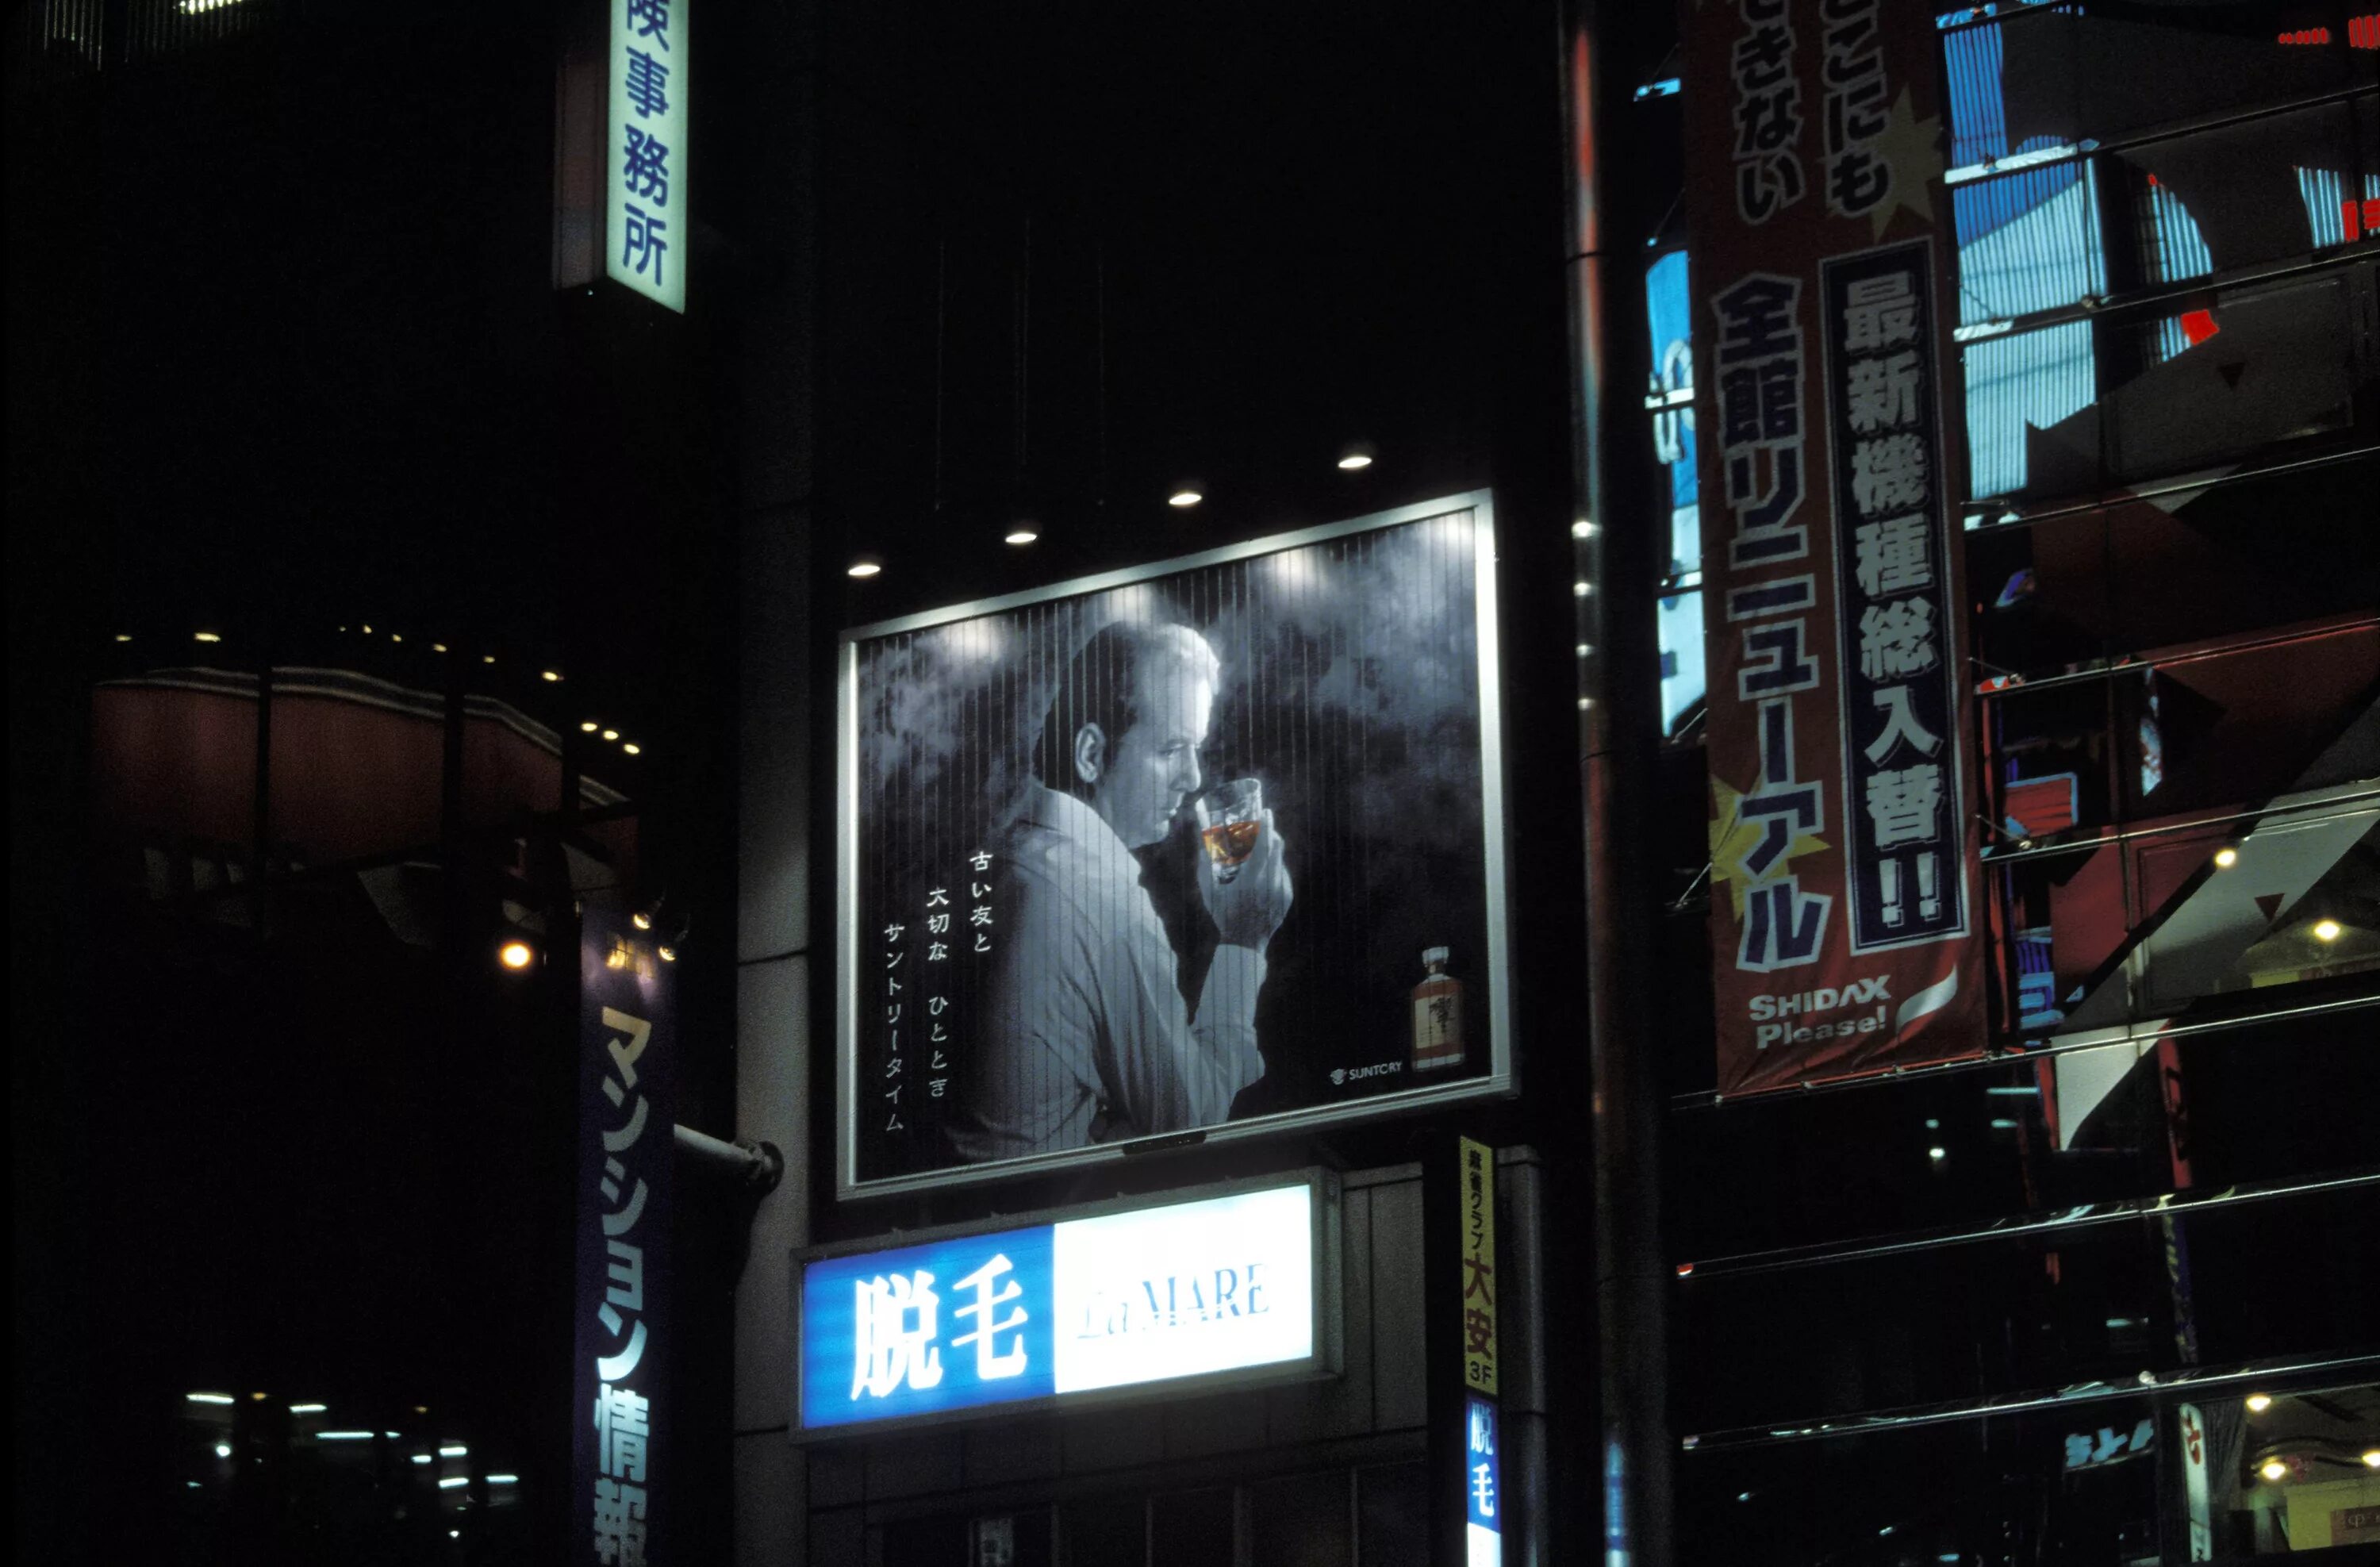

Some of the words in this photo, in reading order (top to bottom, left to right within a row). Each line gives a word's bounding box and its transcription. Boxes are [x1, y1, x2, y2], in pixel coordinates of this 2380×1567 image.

[926, 887, 950, 962] 大切な
[969, 851, 993, 953] 古い友と
[884, 924, 905, 1131] サントリータイム
[1748, 974, 1892, 1022] SHIDAX
[1756, 1005, 1887, 1050] Please!
[593, 1005, 652, 1567] マンション情報
[850, 1254, 1029, 1402] 脱毛
[1470, 1361, 1492, 1385] 3F
[1471, 1402, 1495, 1517] 脱毛
